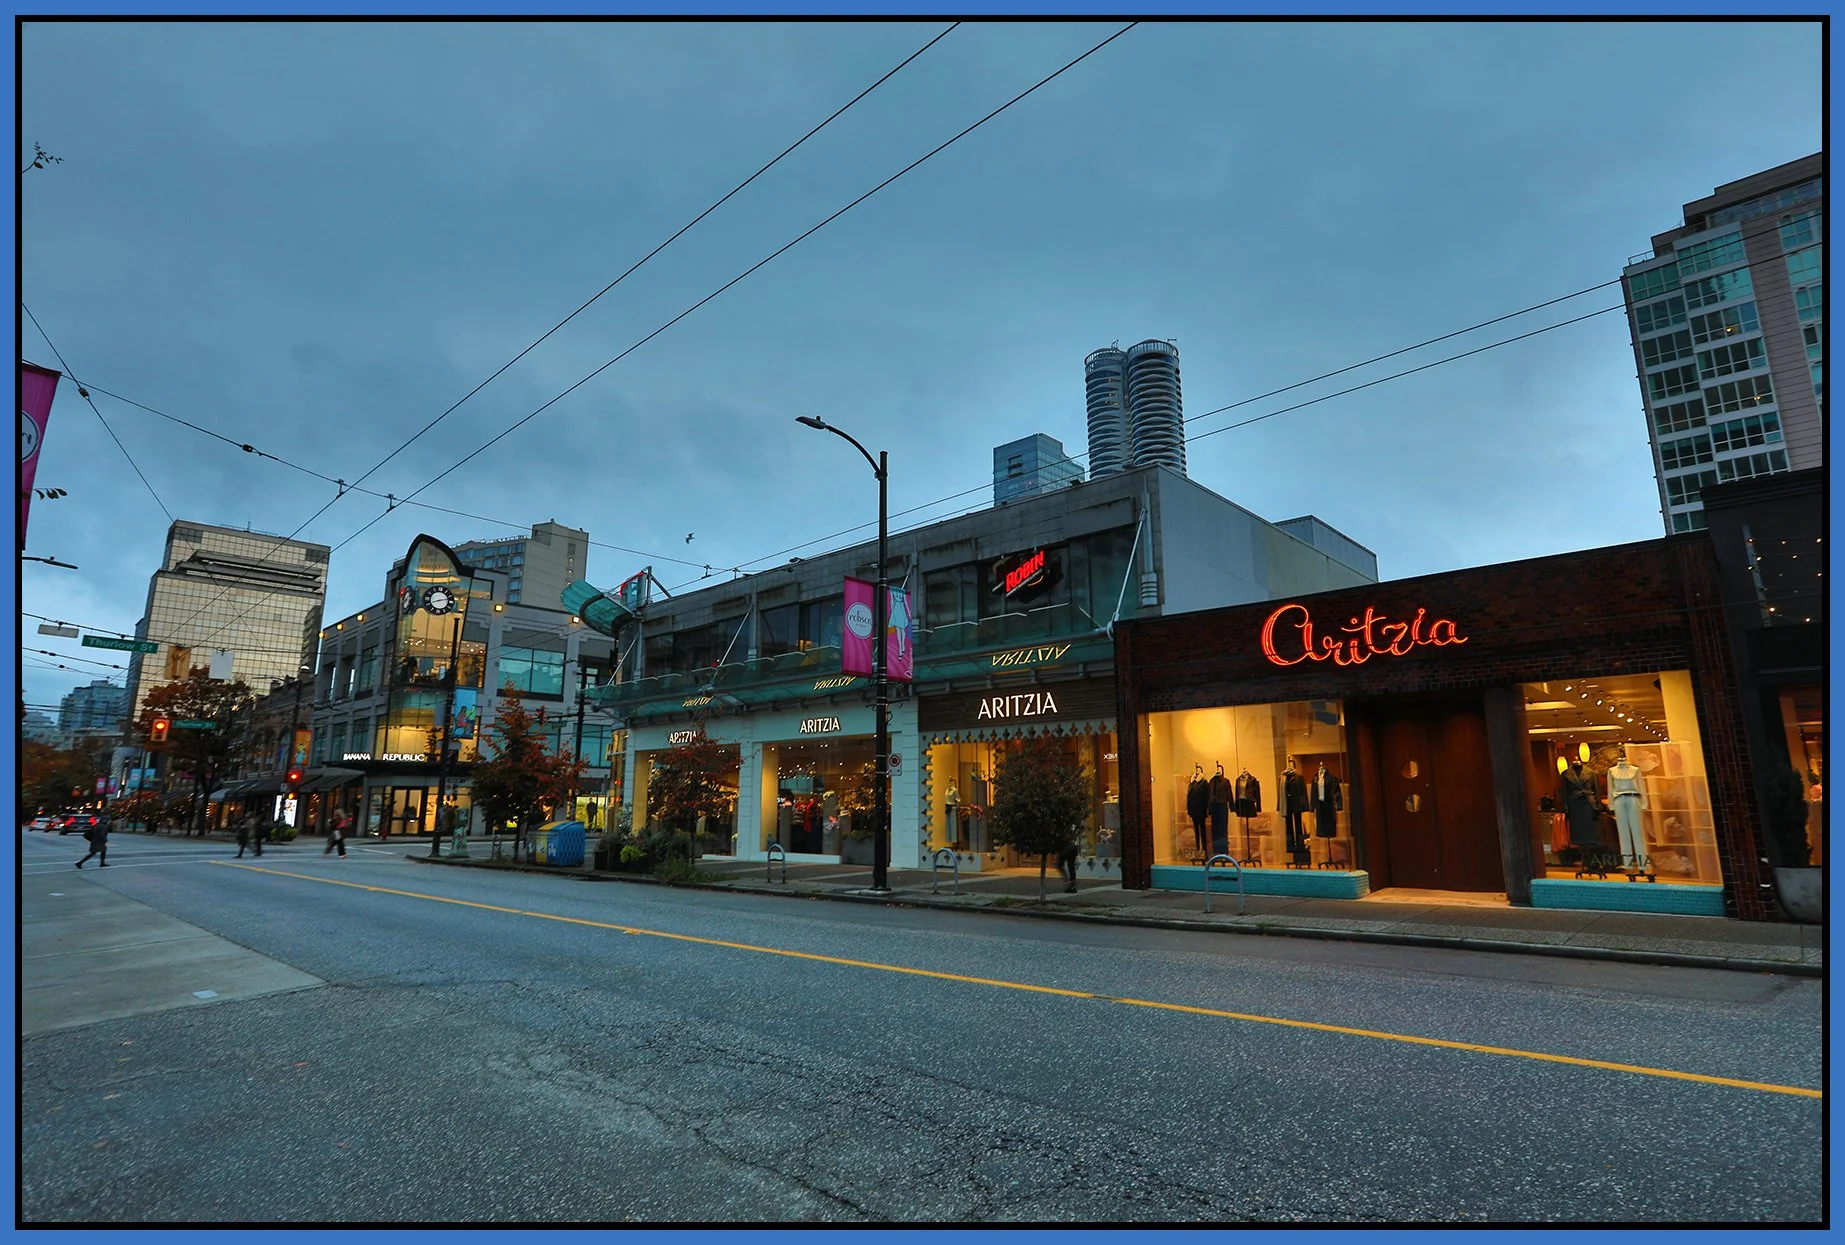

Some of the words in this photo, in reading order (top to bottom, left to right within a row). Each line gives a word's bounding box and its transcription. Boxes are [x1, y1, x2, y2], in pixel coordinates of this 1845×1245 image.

[1005, 550, 1045, 593] ROBIN
[89, 637, 135, 650] Thurlow
[139, 642, 154, 652] St
[1261, 604, 1468, 665] Aritzia
[977, 691, 1058, 720] ARITZIA
[799, 717, 840, 733] ARITZIA
[343, 752, 372, 761] BANANA
[382, 753, 425, 761] REPUBLIC
